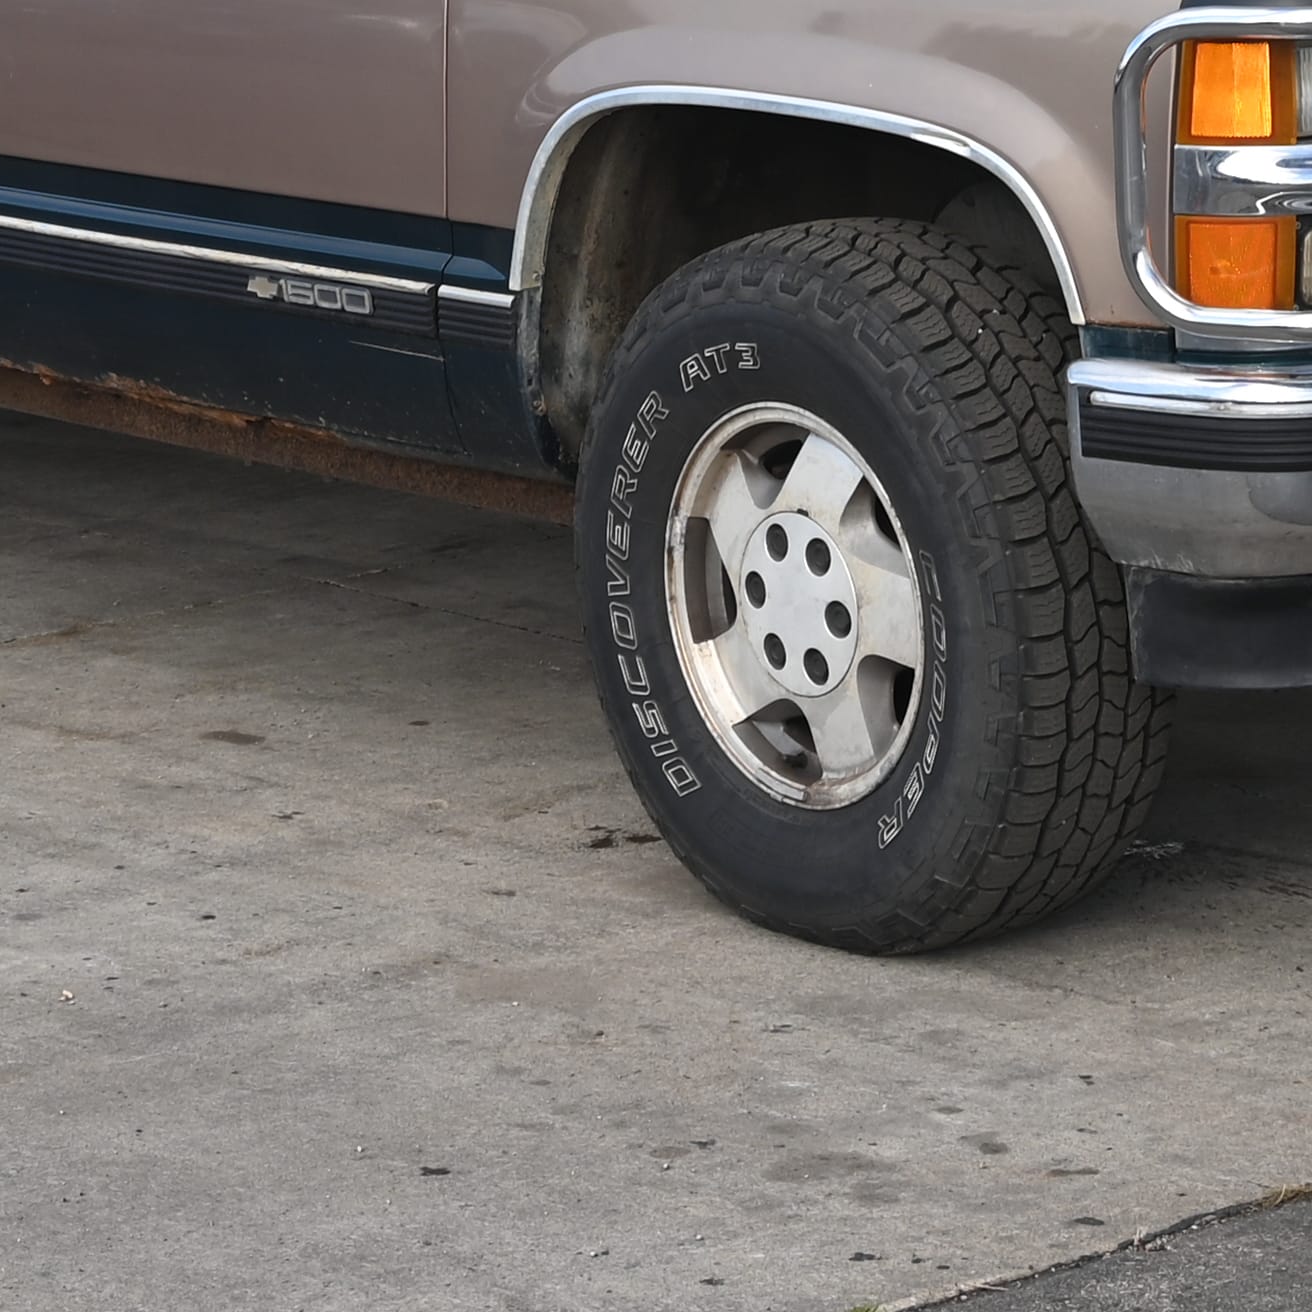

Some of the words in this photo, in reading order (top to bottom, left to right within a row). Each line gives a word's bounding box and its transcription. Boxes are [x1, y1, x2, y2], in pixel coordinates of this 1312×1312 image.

[279, 278, 375, 316] 1500
[605, 390, 702, 797] DISCOVERER
[679, 343, 761, 392] AT3
[878, 549, 948, 849] COOPER
